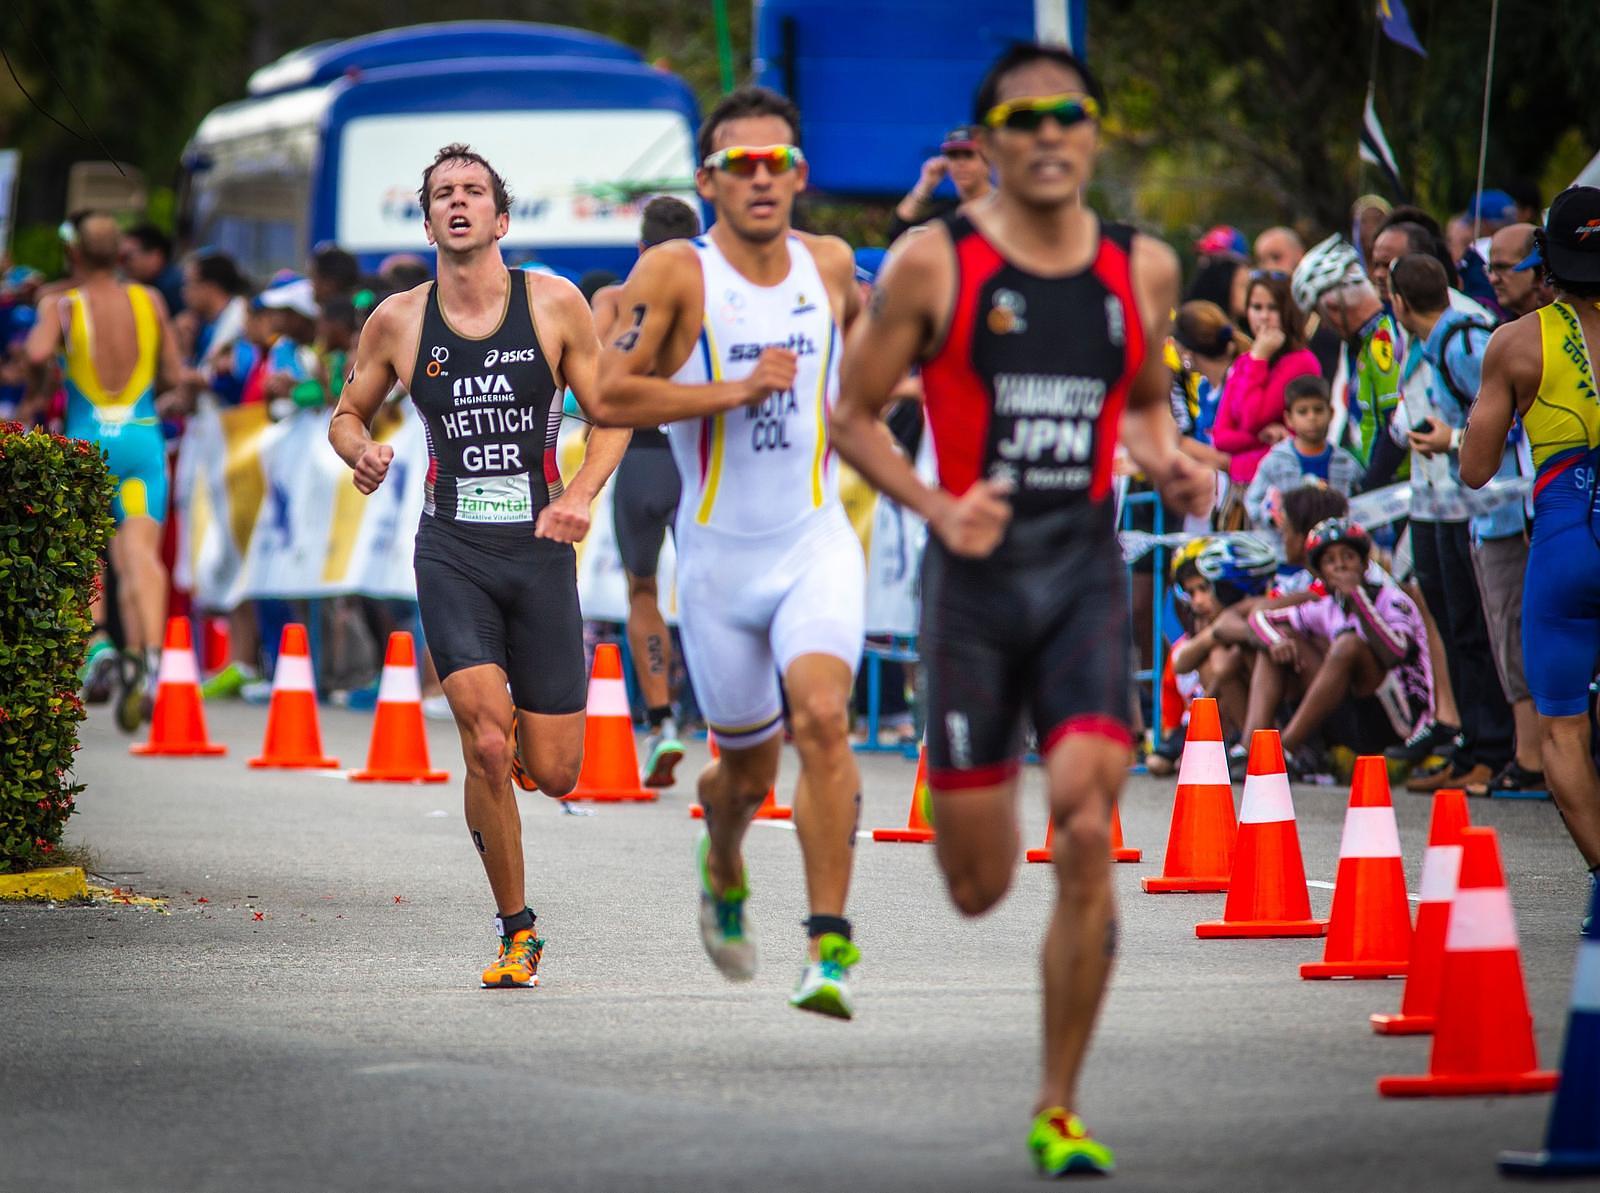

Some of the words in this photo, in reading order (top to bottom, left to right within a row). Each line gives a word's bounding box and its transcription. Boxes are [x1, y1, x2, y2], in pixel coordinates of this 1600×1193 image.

[454, 393, 515, 406] ENGINEERING
[441, 406, 534, 439] HETTICH
[752, 418, 790, 453] COL
[998, 418, 1092, 462] JPN
[462, 443, 523, 472] GER
[462, 496, 528, 512] fairvital
